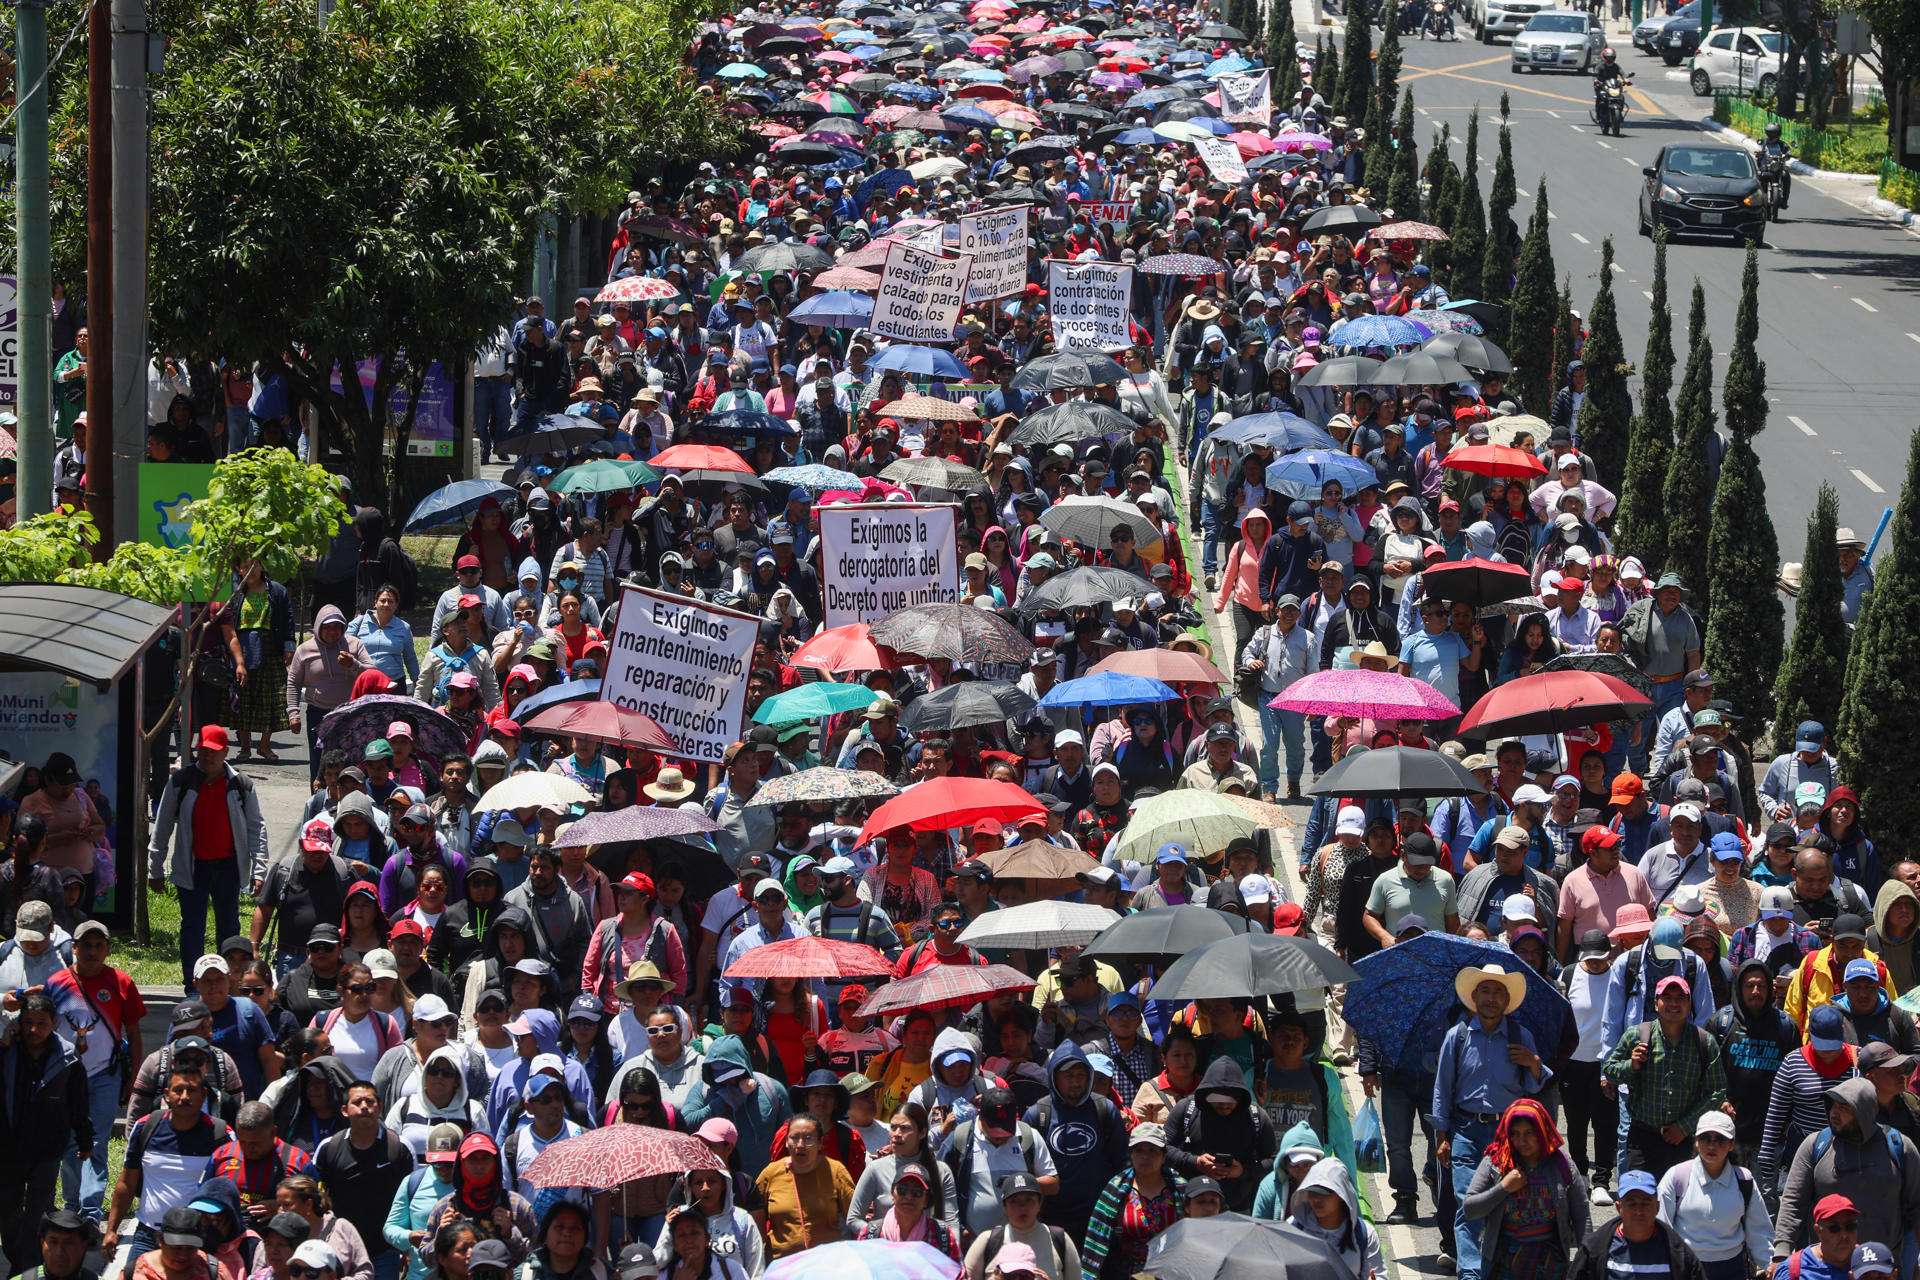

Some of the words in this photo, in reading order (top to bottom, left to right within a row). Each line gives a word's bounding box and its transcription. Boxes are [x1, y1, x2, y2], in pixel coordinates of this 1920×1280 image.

[976, 213, 1017, 232] Exigimos
[966, 235, 975, 248] Q
[903, 250, 957, 275] Exigimos
[974, 245, 1025, 264] alimentación
[888, 265, 953, 288] vestimenta
[955, 277, 965, 292] y
[997, 267, 1003, 281] y
[1007, 259, 1027, 275] leche
[1066, 267, 1118, 284] Exigimos
[930, 292, 960, 308] para
[1054, 285, 1125, 301] contratación
[925, 307, 945, 321] los
[1053, 301, 1067, 315] de
[1070, 301, 1120, 318] docentes
[1122, 307, 1129, 322] y
[877, 320, 948, 339] estudiantes
[1060, 321, 1109, 334] procesos
[1111, 321, 1124, 336] de
[851, 518, 912, 551] Exigimos
[915, 516, 927, 543] la
[839, 552, 916, 585] derogatoria
[919, 550, 941, 576] del
[828, 584, 877, 612] Decreto
[881, 590, 907, 614] que
[652, 602, 729, 642] Exigimos
[617, 630, 745, 683] mantenimiento,
[624, 664, 716, 702] reparación
[716, 689, 730, 711] y
[1861, 1246, 1878, 1262] LA
